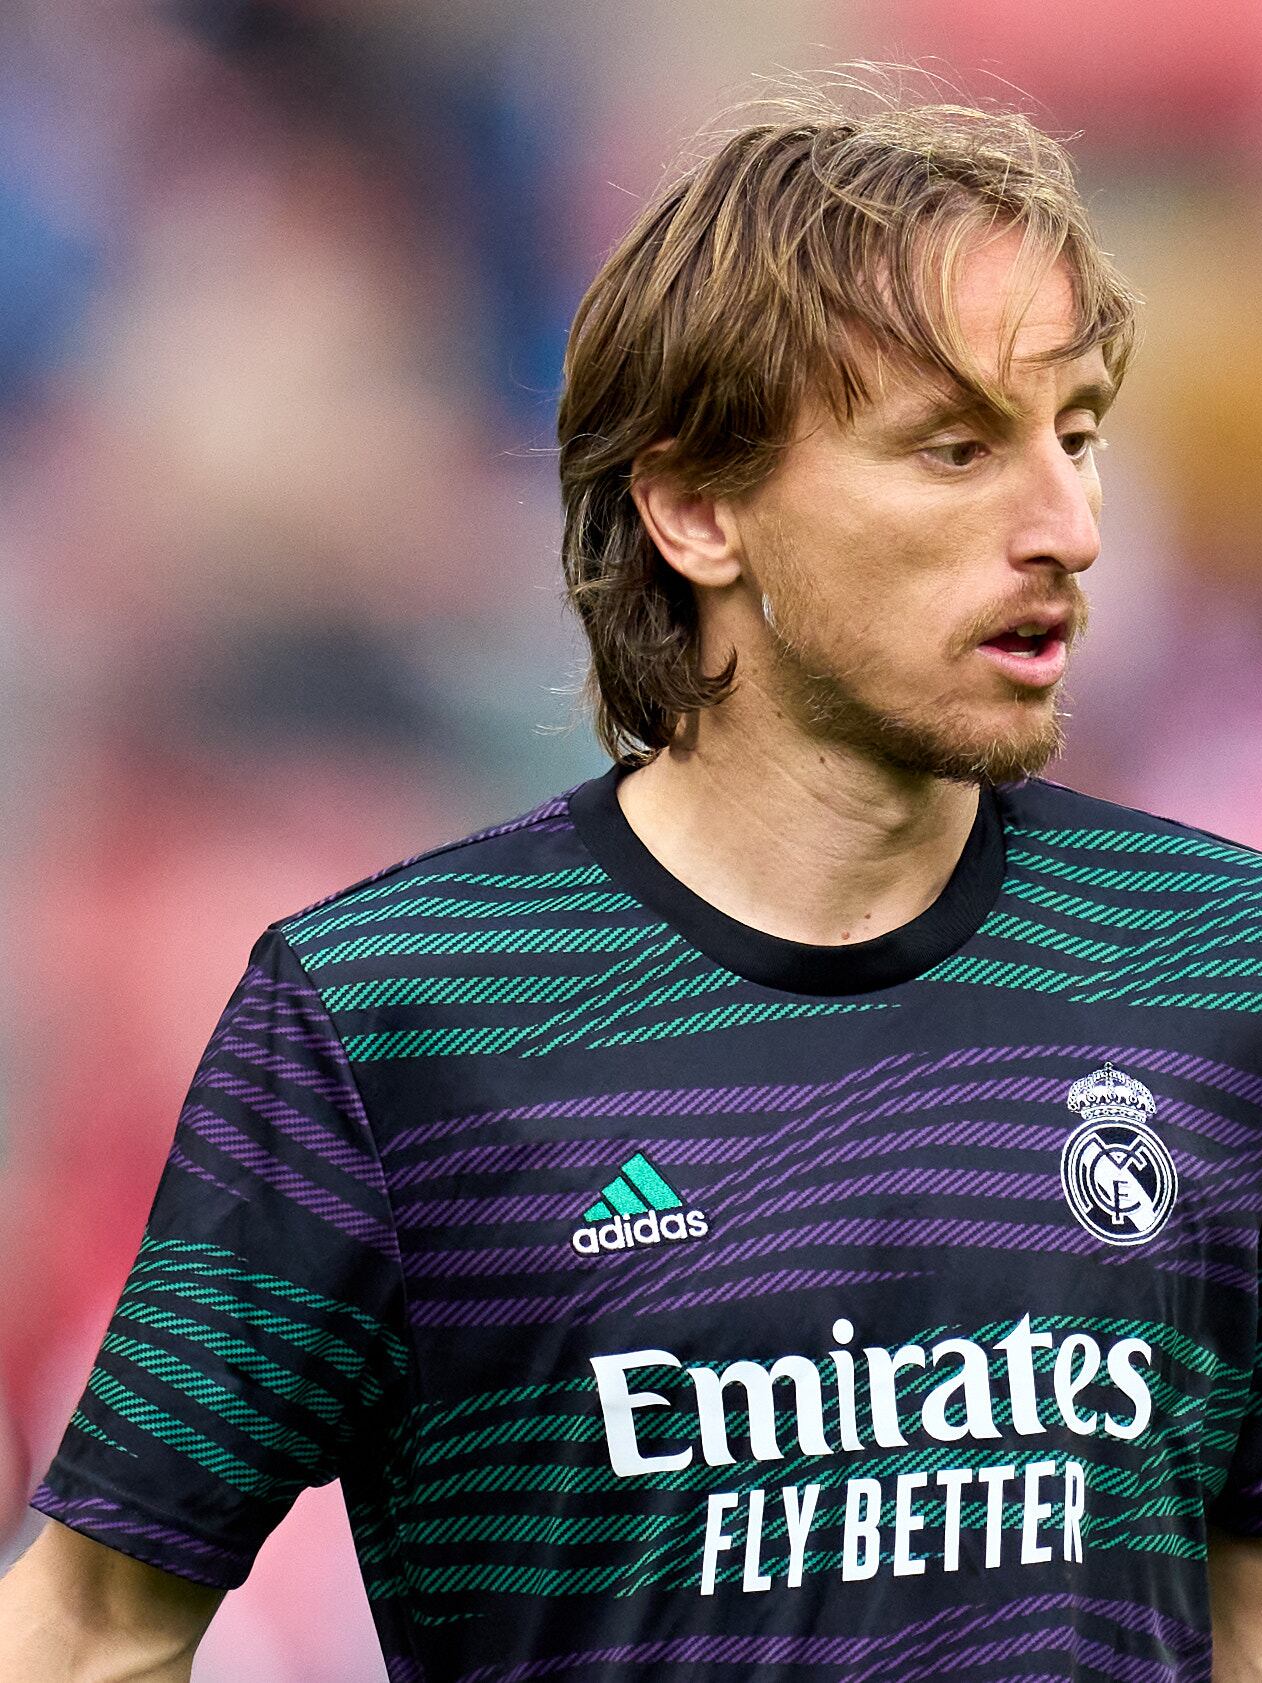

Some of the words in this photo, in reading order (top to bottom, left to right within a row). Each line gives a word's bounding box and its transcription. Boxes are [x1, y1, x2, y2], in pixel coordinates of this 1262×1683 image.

[573, 1208, 709, 1256] adidas
[590, 1313, 1152, 1477] Emirates
[701, 1484, 821, 1596] FLY
[842, 1461, 1085, 1582] BETTER
